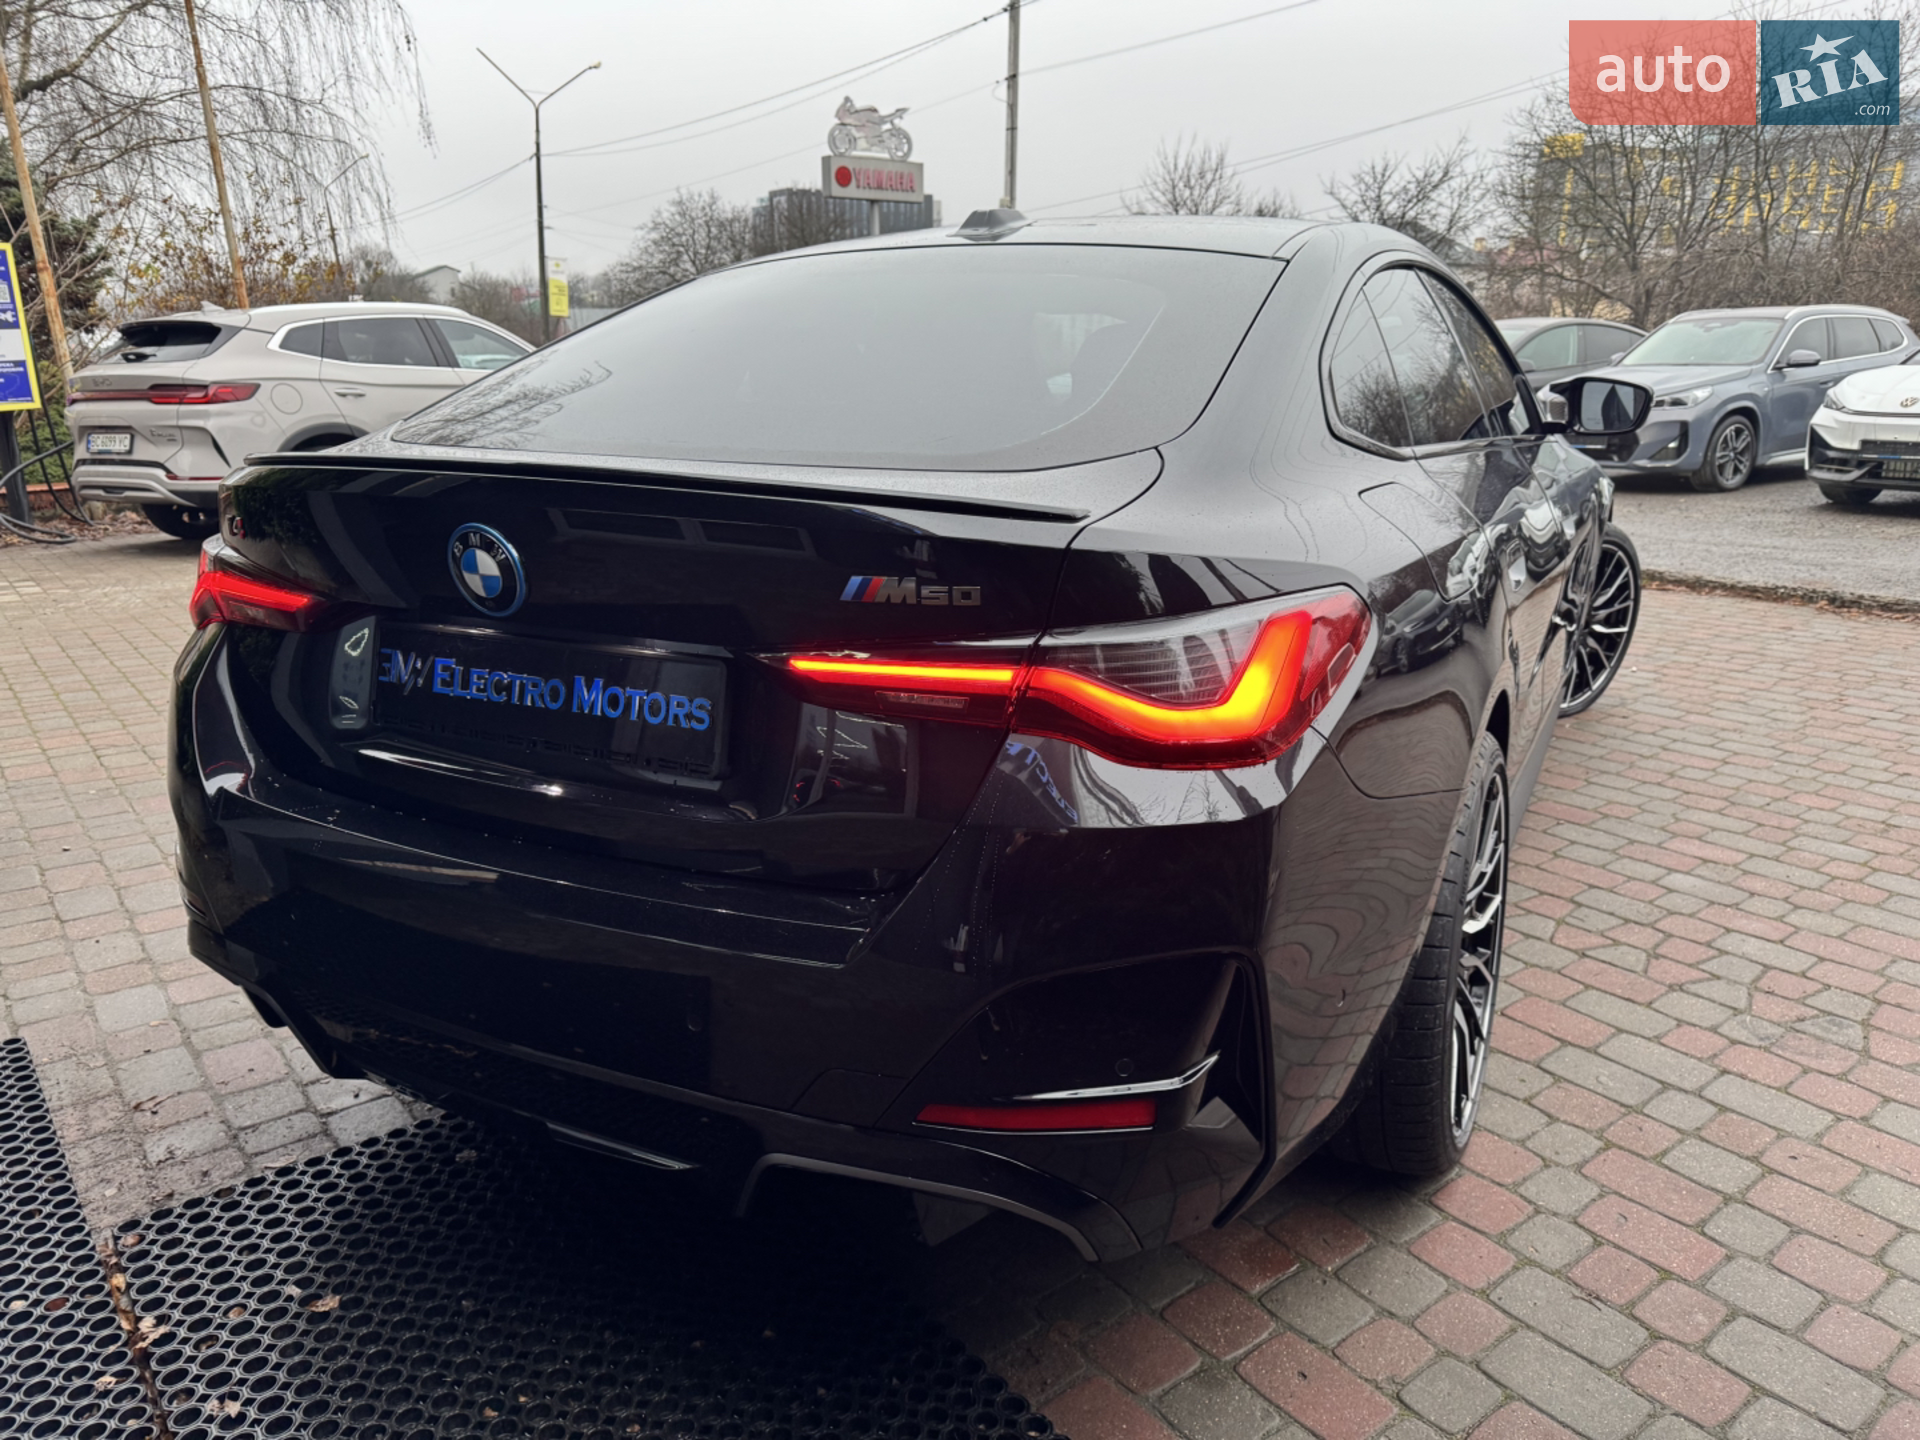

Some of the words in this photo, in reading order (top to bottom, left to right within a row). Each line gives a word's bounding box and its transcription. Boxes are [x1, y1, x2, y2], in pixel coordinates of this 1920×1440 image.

[852, 167, 916, 193] YAMAHA
[453, 532, 506, 563] BMW
[873, 576, 982, 606] M50
[432, 657, 567, 710] ELECTRO
[571, 675, 713, 731] MOTORS
